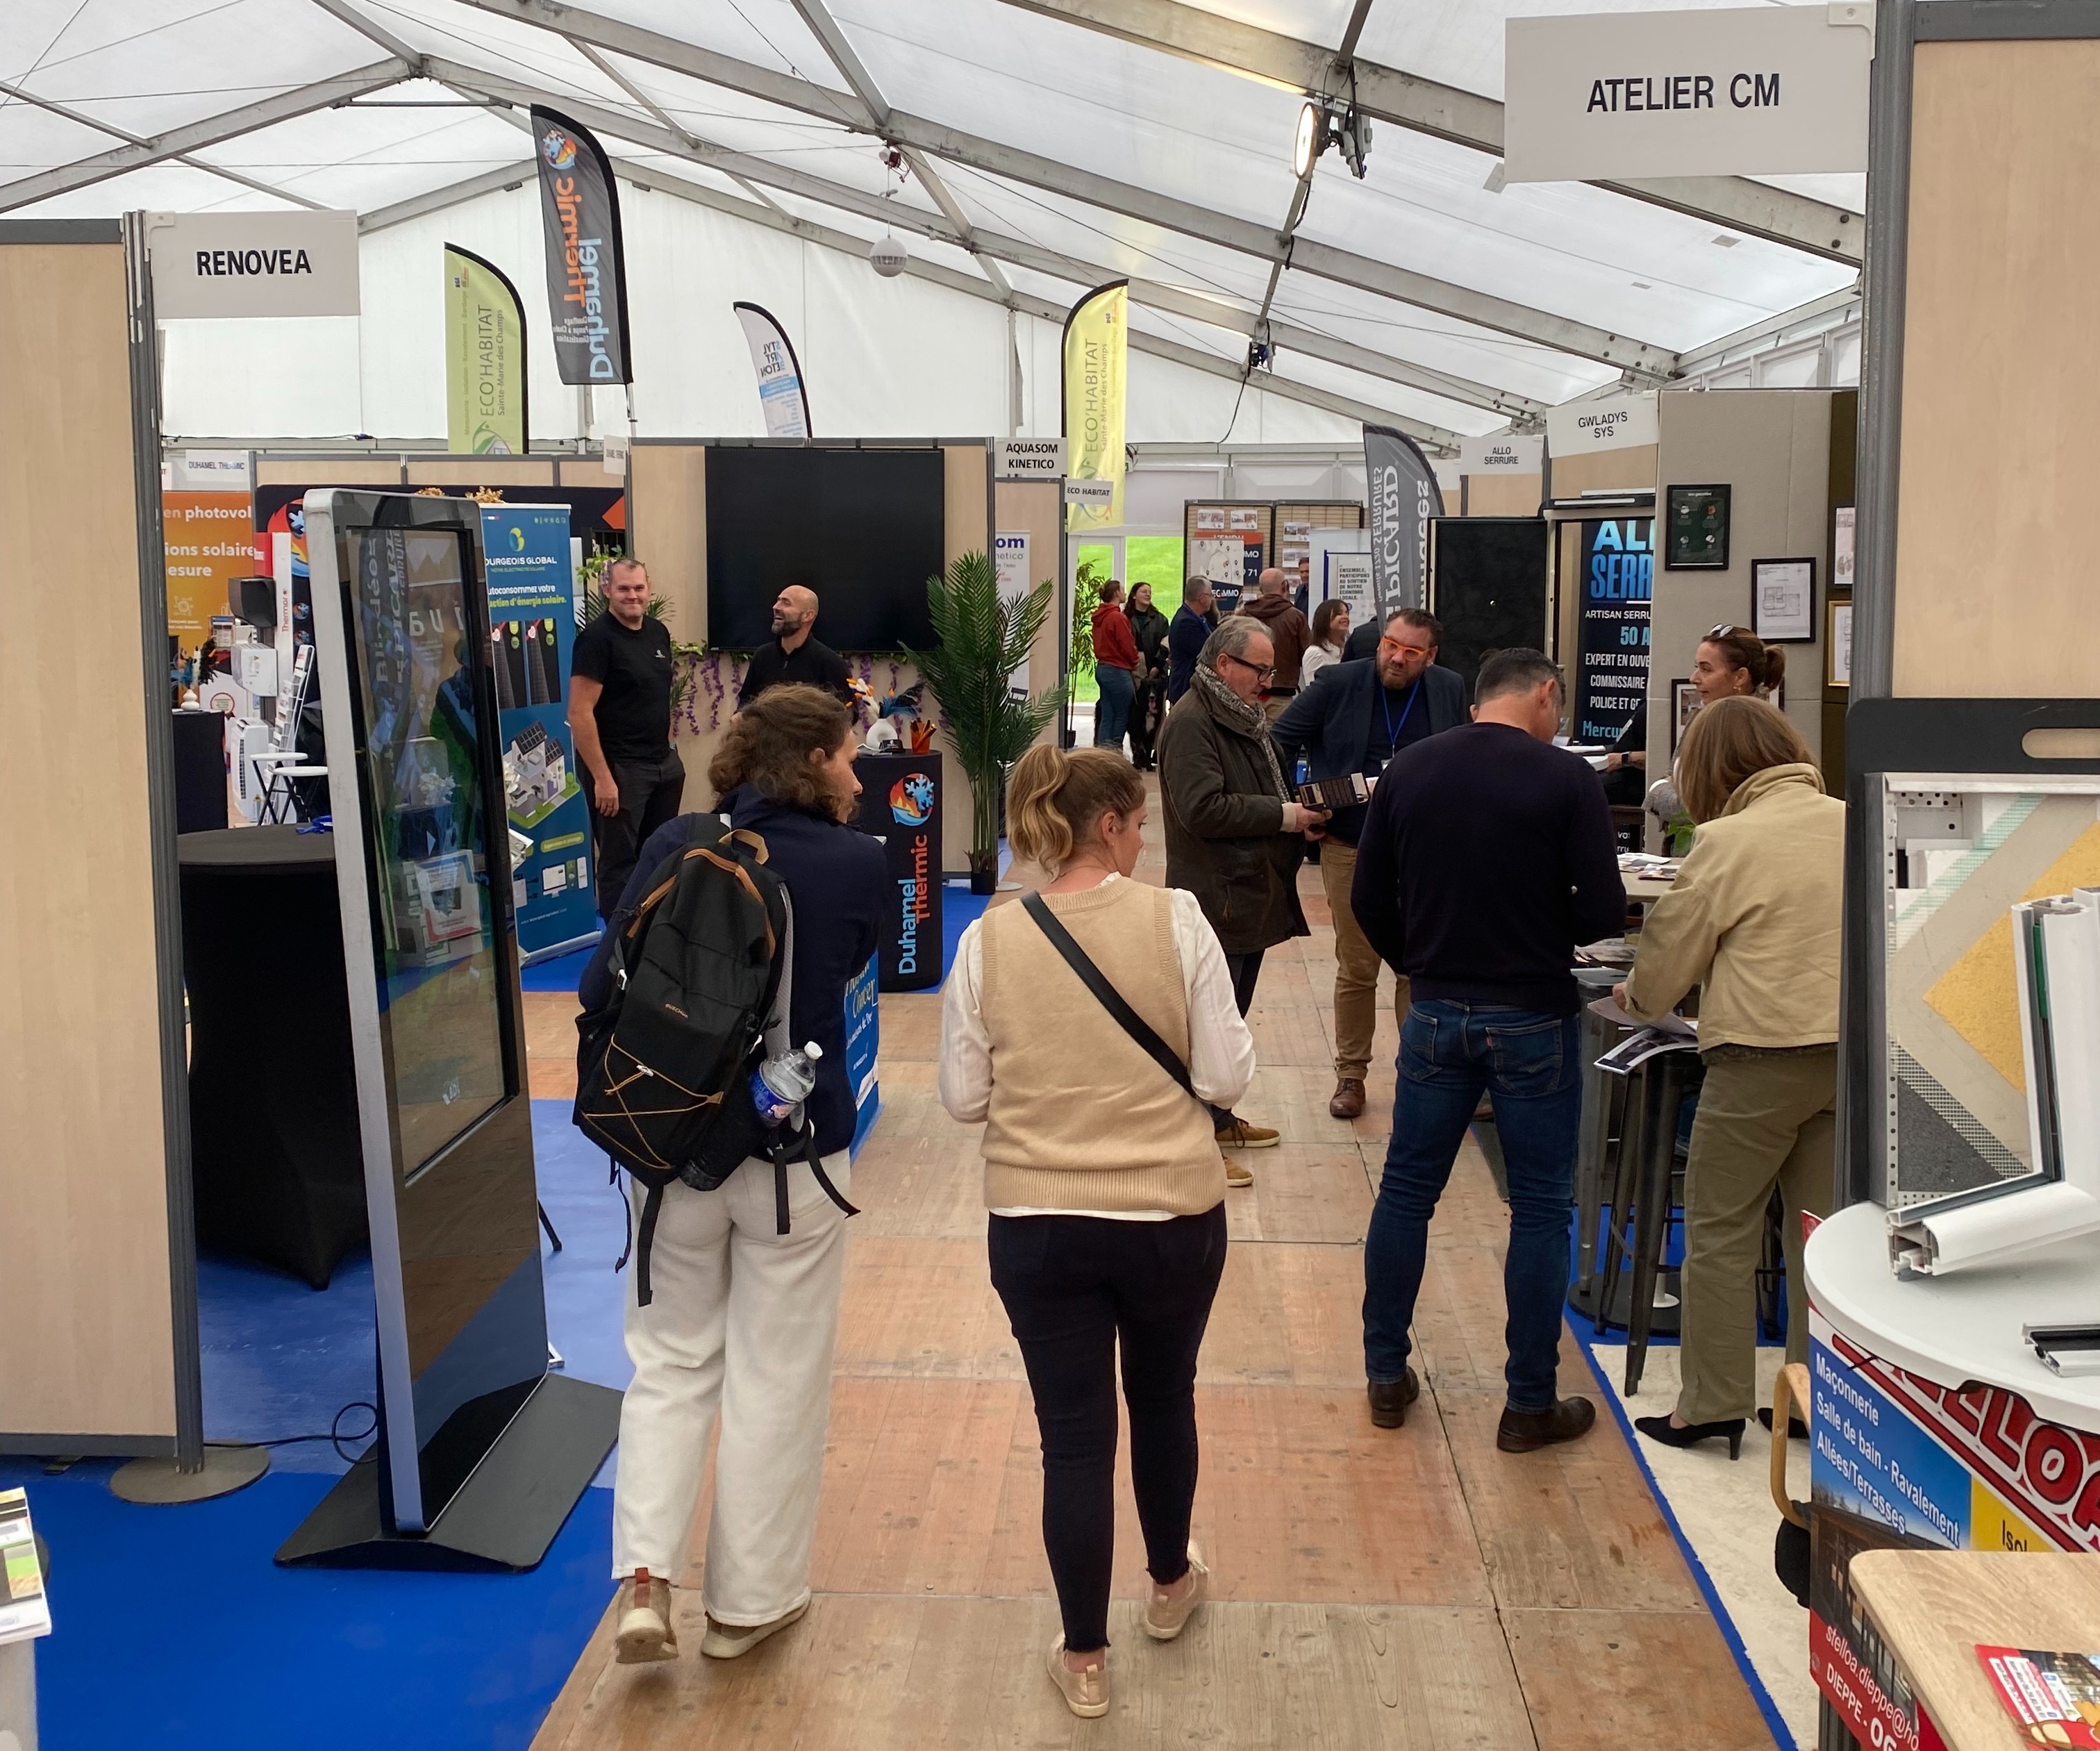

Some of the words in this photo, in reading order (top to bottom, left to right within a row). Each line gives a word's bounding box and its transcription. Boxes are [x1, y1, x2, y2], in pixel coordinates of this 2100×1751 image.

[1587, 75, 1714, 113] ATELIER
[1730, 74, 1780, 108] CM
[197, 249, 312, 276] RENOVEA
[496, 310, 505, 343] Champs
[477, 304, 494, 417] ECO'HABITAT
[497, 363, 505, 416] Sainte-Marie
[1085, 338, 1099, 453] ECO'HABITAT
[1578, 412, 1628, 428] GWLADYS
[1594, 426, 1614, 438] SYS
[1006, 443, 1058, 455] AQUASOM
[1492, 447, 1511, 455] ALLO
[189, 461, 216, 470] DUHAMEL
[1008, 459, 1054, 469] KINETICO
[1484, 456, 1519, 465] SERRURE
[185, 506, 251, 522] photovol
[526, 556, 557, 565] GLOBAL
[167, 566, 212, 576] esure
[538, 584, 556, 593] votre
[1585, 611, 1622, 619] ARTISAN
[1620, 626, 1638, 646] 50
[1585, 654, 1616, 665] EXPERT
[1617, 655, 1628, 667] EN
[1590, 674, 1645, 689] COMMISSAIRE
[1590, 696, 1617, 709] POLICE
[1619, 697, 1629, 710] ET
[910, 833, 931, 924] Thermic
[898, 879, 916, 974] Duhamel
[1815, 1352, 1880, 1427] Maçonnerie
[1816, 1391, 1842, 1432] Salle
[1843, 1418, 1856, 1445] de
[1858, 1431, 1882, 1470] bain
[1890, 1460, 1960, 1549] Ravalement
[1816, 1429, 1906, 1535] Allées/Terrasses
[1826, 1662, 1863, 1723] DIEPPE
